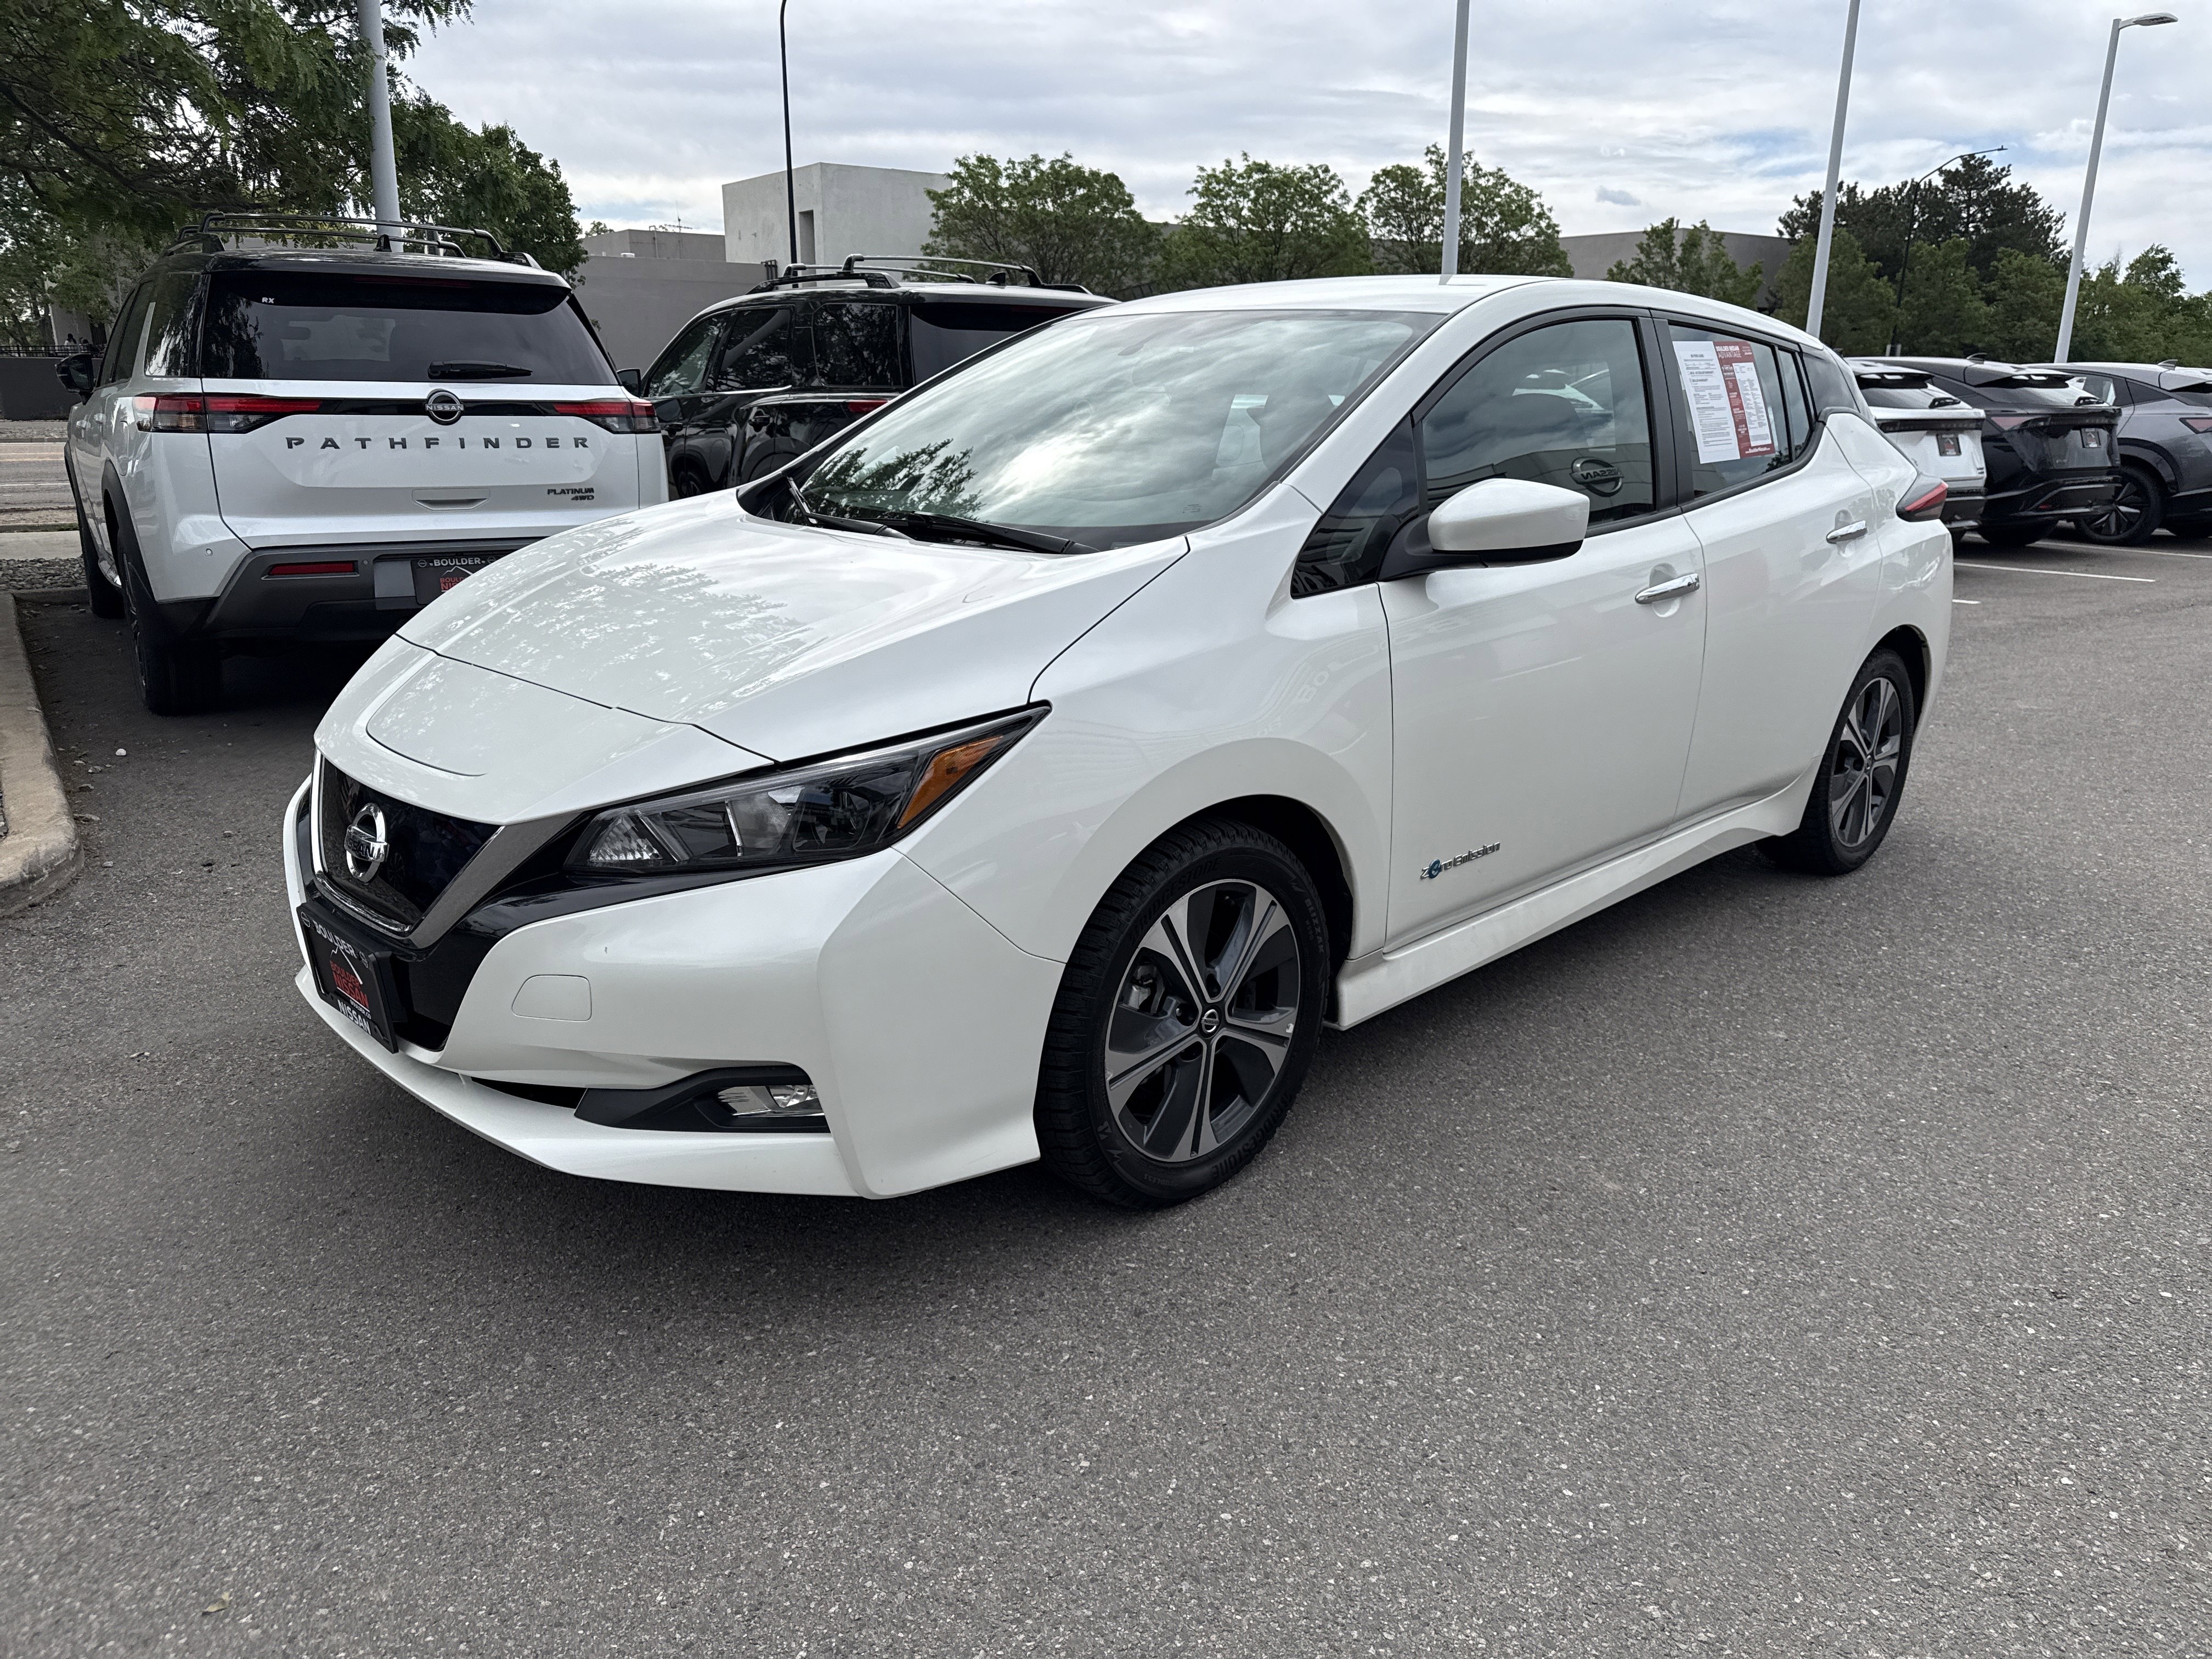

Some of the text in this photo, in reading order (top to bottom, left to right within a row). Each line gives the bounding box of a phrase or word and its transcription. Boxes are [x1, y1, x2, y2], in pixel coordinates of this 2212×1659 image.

[286, 437, 589, 449] PATHFINDER
[433, 557, 481, 566] BOULDER
[313, 919, 358, 959] BOULDER
[1304, 898, 1324, 953] BLIZZAK
[330, 960, 360, 986] BOULDER
[333, 971, 369, 1009] NISSAN
[337, 999, 371, 1035] NISSAN
